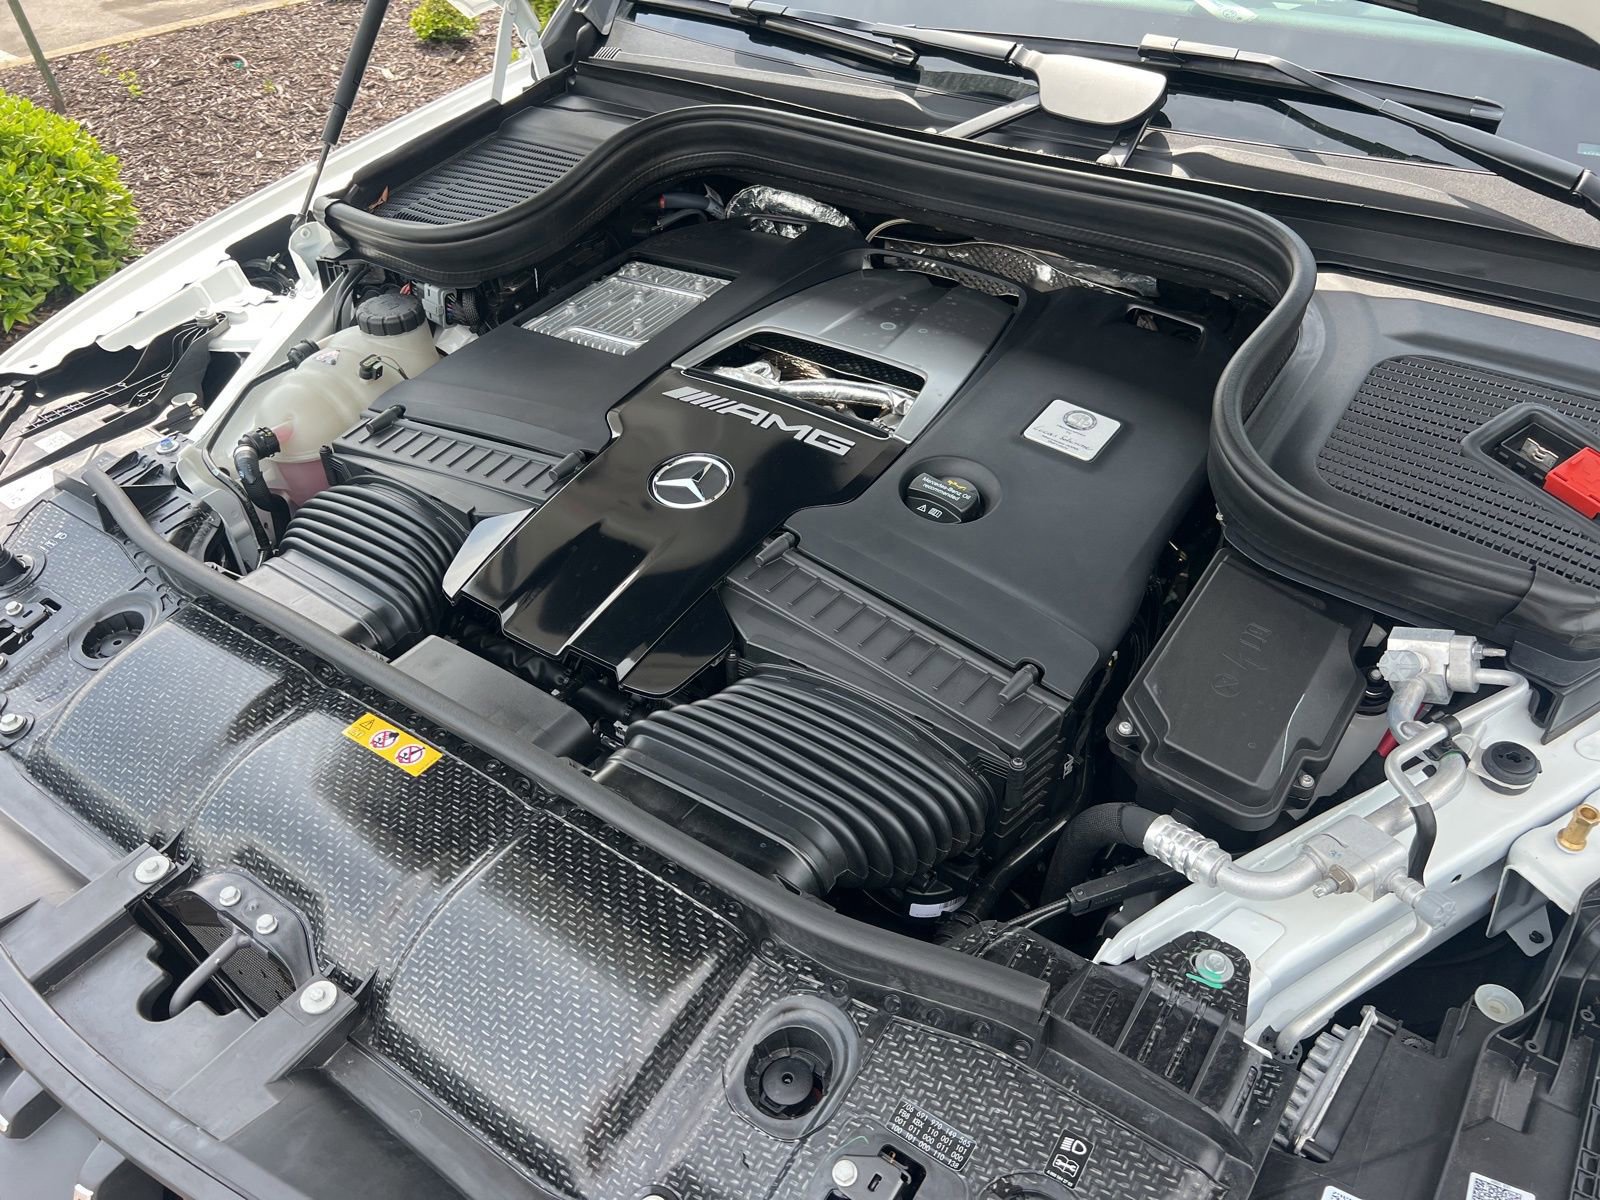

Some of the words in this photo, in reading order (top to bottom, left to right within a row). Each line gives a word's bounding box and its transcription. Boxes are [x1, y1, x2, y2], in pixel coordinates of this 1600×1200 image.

[721, 402, 856, 457] AMG
[922, 476, 962, 496] Mercedes-Benz
[922, 484, 960, 501] recommended
[891, 1124, 903, 1133] 100
[905, 1133, 916, 1142] 101
[918, 1141, 930, 1151] 000
[933, 1151, 944, 1160] 110
[948, 1159, 959, 1168] 138
[895, 1117, 906, 1126] 001
[908, 1125, 920, 1135] 011
[922, 1134, 935, 1143] 000
[937, 1143, 948, 1153] 011
[951, 1152, 964, 1161] 000
[902, 1102, 914, 1112] 706
[916, 1111, 928, 1120] 691
[931, 1120, 943, 1129] 970
[945, 1129, 957, 1138] 149
[959, 1137, 970, 1147] 565
[912, 1118, 924, 1128] KBX
[927, 1127, 938, 1136] 110
[941, 1135, 952, 1145] 001
[956, 1145, 967, 1154] 101
